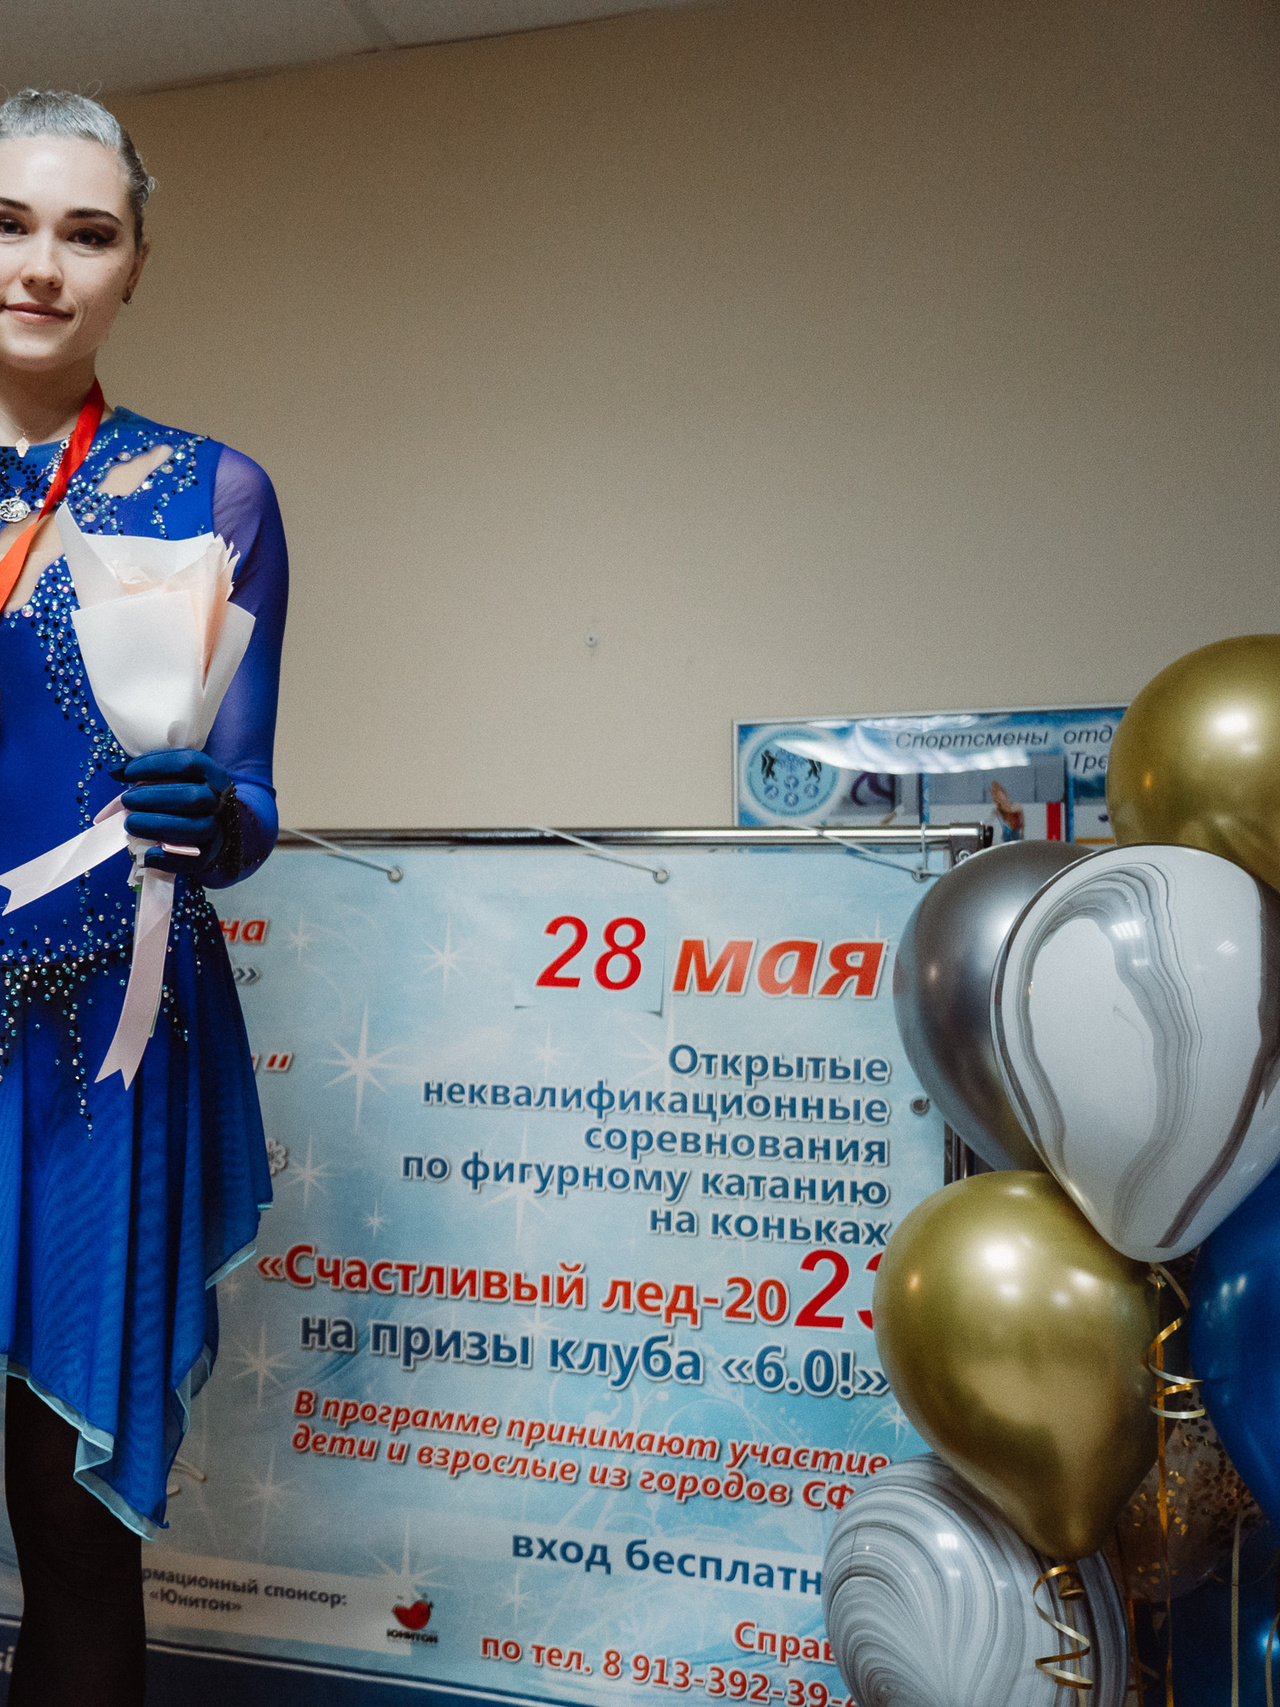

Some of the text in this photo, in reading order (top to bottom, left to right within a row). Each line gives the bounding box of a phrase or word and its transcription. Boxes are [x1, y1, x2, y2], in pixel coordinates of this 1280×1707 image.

[895, 723, 1113, 751] Спортсмены отд
[535, 914, 886, 998] 28 мая
[668, 1043, 890, 1086] Открытые
[422, 1080, 890, 1122] неквалификационные
[584, 1124, 888, 1165] соревнования
[401, 1152, 890, 1207] по фигурному катанию
[649, 1208, 889, 1247] на коньках
[257, 1244, 586, 1311] «Счастливый
[300, 1316, 890, 1397] на призы клуба «6.0!»
[293, 1389, 889, 1477] В программе принимают участие
[292, 1422, 378, 1460] дети
[385, 1441, 408, 1463] и
[416, 1446, 578, 1483] взрослые
[588, 1464, 628, 1488] из
[638, 1469, 792, 1506] городов
[512, 1533, 823, 1596] вход бесплатн
[148, 1588, 243, 1613] «Юнитон»
[263, 1584, 348, 1609] спонсор:
[480, 1636, 522, 1662] по
[531, 1642, 593, 1674] тел.
[602, 1650, 622, 1679] 8
